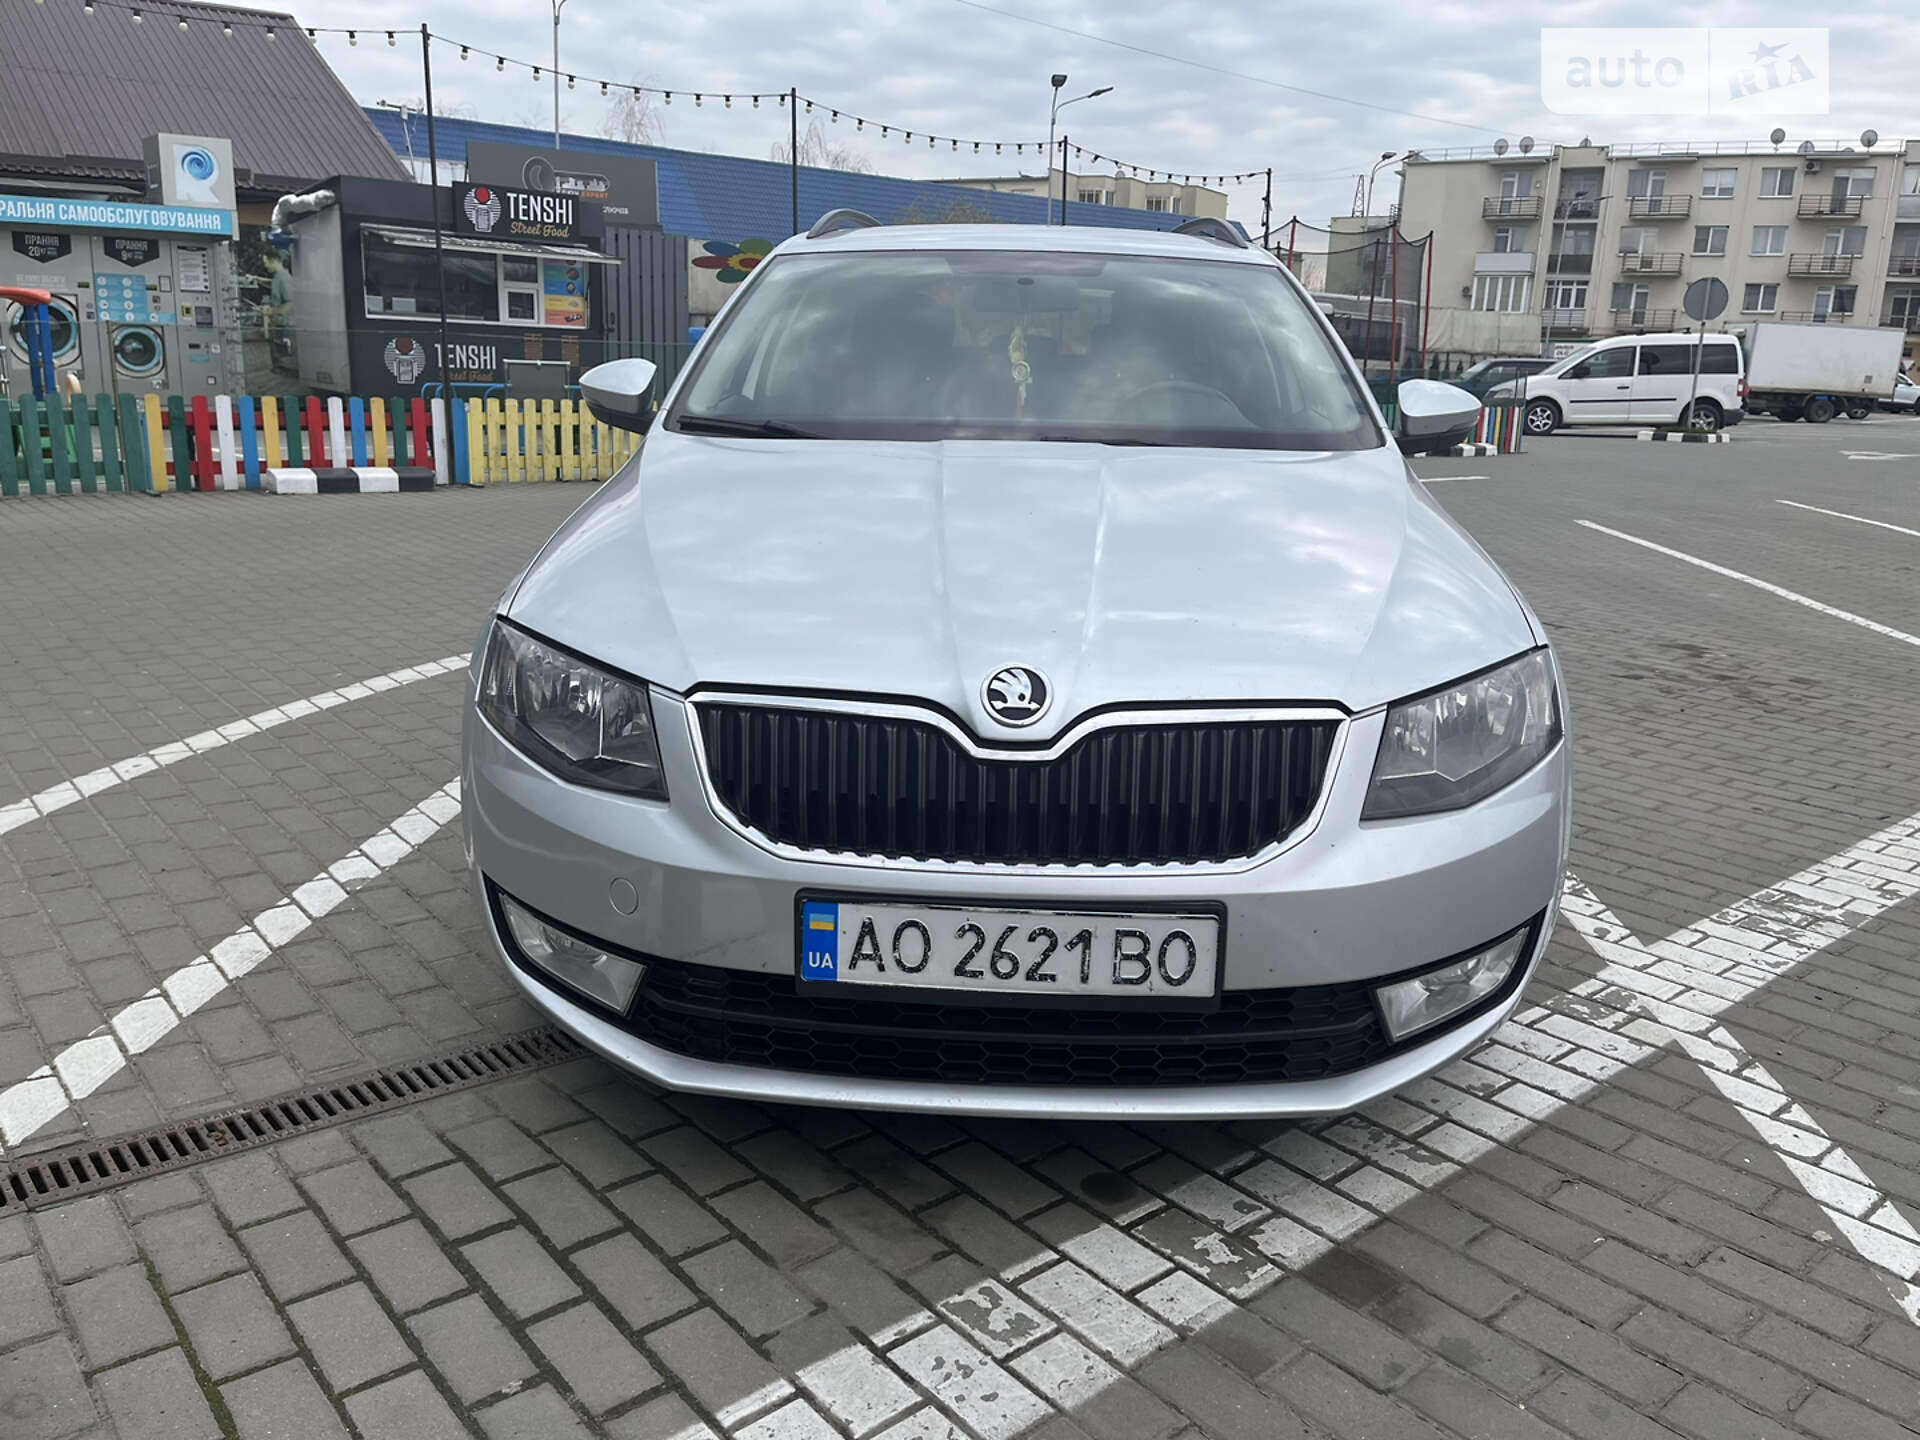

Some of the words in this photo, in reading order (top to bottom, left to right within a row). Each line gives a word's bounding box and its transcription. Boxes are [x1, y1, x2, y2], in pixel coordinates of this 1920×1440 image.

[59, 203, 221, 230] САМООБСЛУГОВУВАННЯ
[506, 192, 573, 225] TENSHI
[25, 234, 59, 247] ПРАННЯ
[510, 221, 542, 235] Street
[543, 223, 570, 238] Food
[115, 239, 148, 252] ПРАННЯ
[434, 343, 497, 370] TENSHI
[808, 951, 834, 970] UA
[848, 915, 932, 974] AO
[953, 922, 1093, 985] 2621
[1111, 927, 1198, 988] BO
